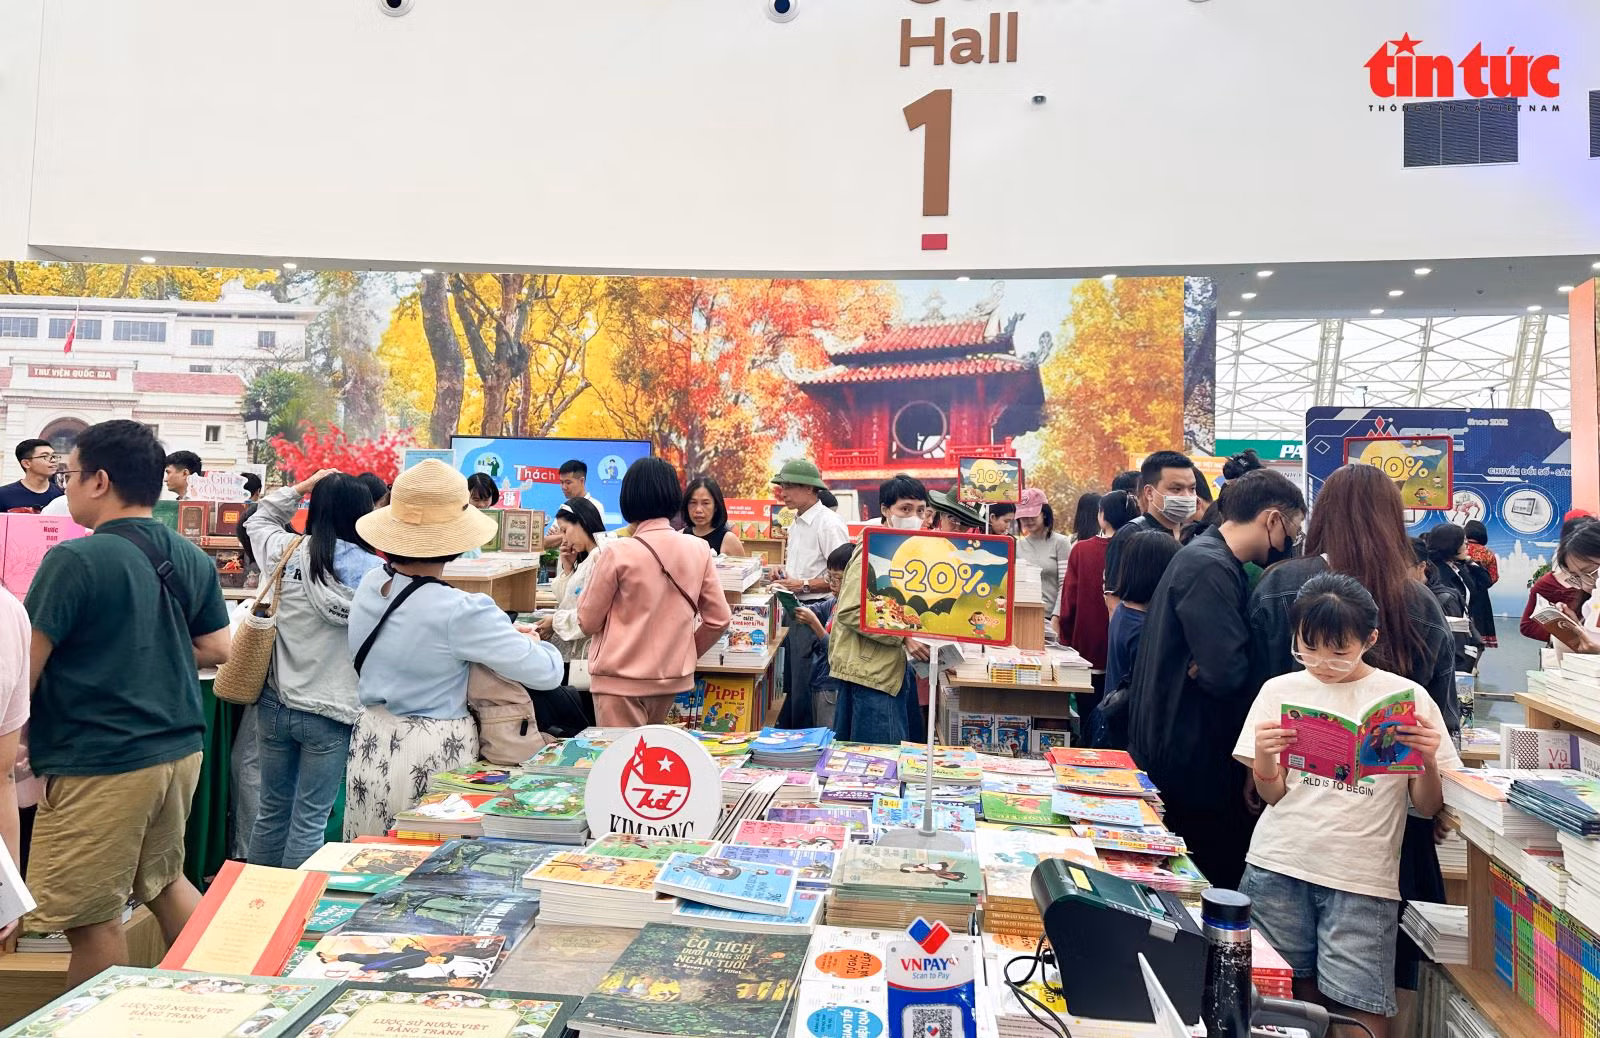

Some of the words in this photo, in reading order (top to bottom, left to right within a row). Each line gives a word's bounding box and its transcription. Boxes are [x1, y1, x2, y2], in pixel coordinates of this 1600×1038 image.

[899, 12, 1018, 67] Hall
[902, 88, 953, 217] 1
[34, 367, 50, 376] THƯ
[51, 368, 71, 377] VIỆN
[97, 370, 112, 378] GIA
[1467, 417, 1489, 427] Since
[514, 464, 557, 481] Thách
[969, 468, 1012, 484] -10%
[888, 559, 991, 597] -20%
[704, 682, 745, 701] Pippi
[1300, 776, 1321, 787] RLD
[1322, 777, 1329, 787] IS
[1332, 780, 1344, 791] TO
[1346, 784, 1374, 797] BEGIN
[715, 939, 755, 954] TÍCH
[676, 954, 713, 966] NGÀN
[717, 957, 747, 970] TUỔI
[912, 971, 928, 980] Scan
[929, 972, 937, 980] to
[938, 972, 950, 980] Pay
[166, 1012, 207, 1020] TRANH
[423, 1027, 465, 1036] TRANH
[429, 1019, 458, 1029] NƯỚC
[462, 1022, 491, 1031] VIỆT
